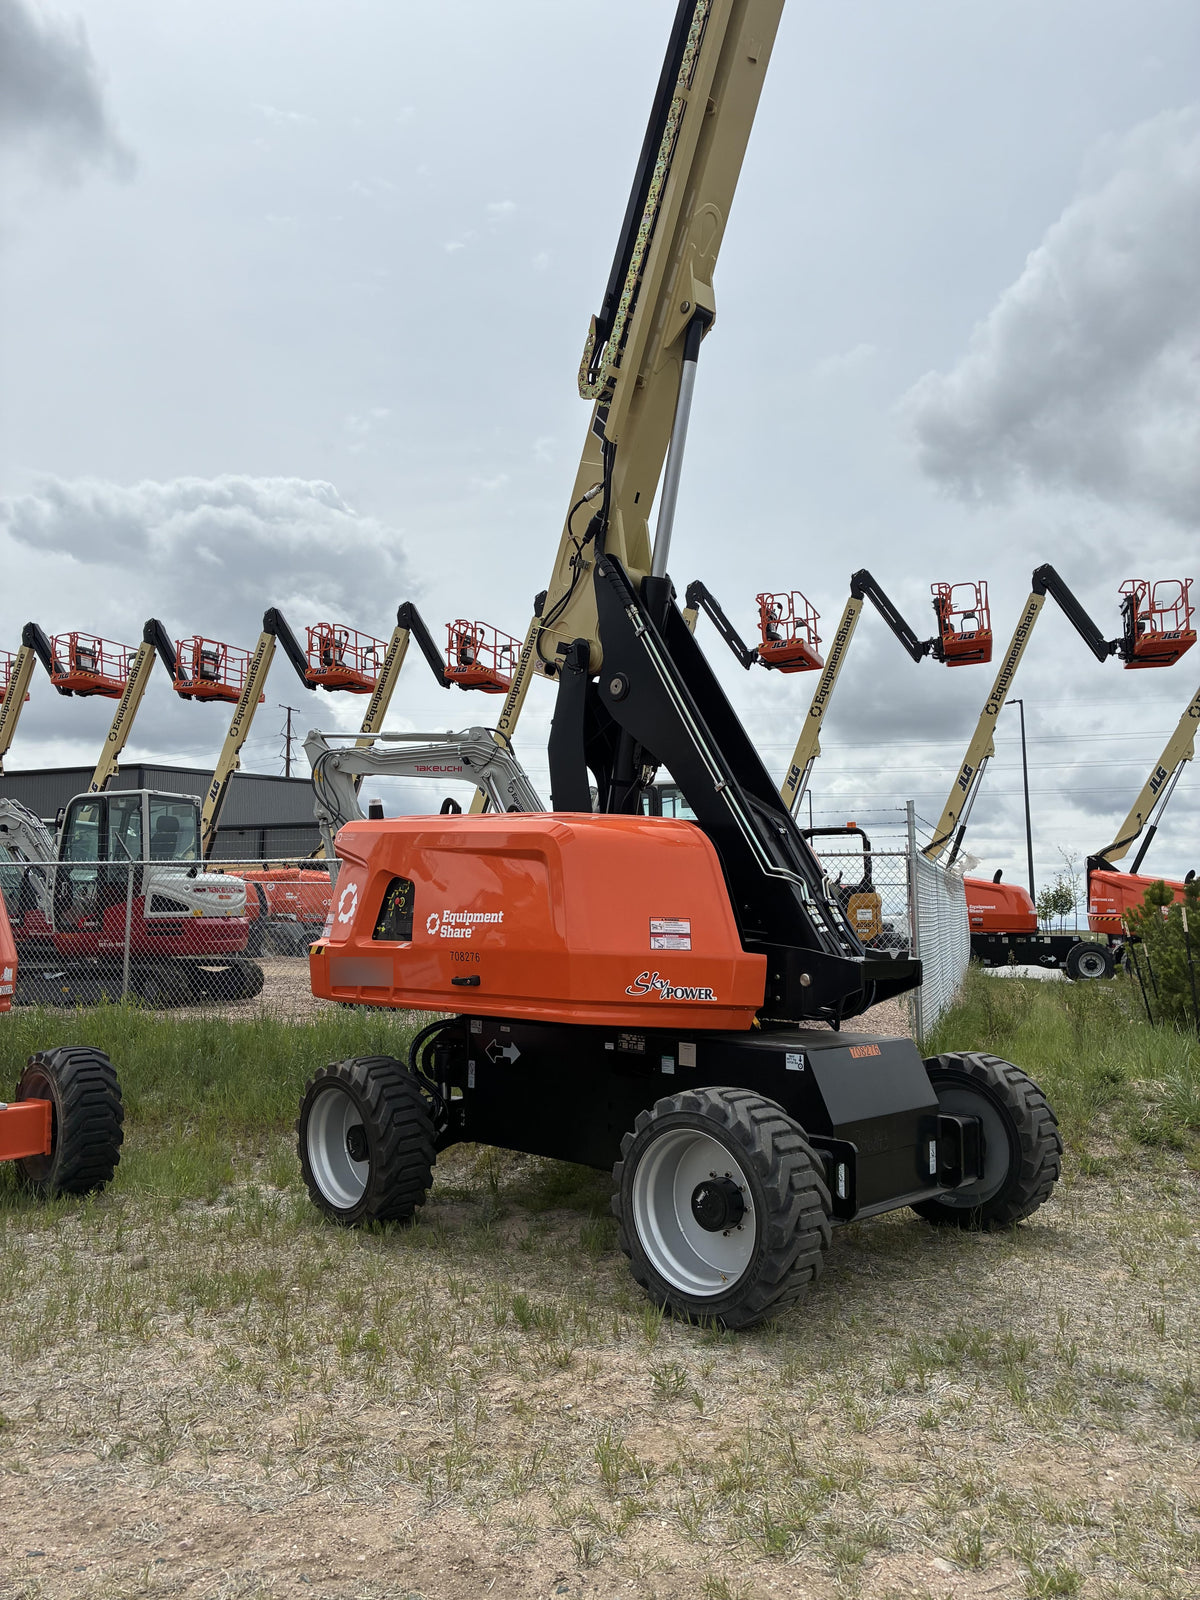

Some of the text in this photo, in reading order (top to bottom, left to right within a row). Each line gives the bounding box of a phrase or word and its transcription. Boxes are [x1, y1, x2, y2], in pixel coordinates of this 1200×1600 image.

[771, 640, 788, 648] JLG
[957, 631, 976, 640] JLG
[1160, 631, 1181, 640] JLG
[814, 608, 856, 705] EquipmentShare
[991, 602, 1038, 702] EquipmentShare
[234, 641, 267, 726] EquipmentShare
[366, 636, 401, 722] EquipmentShare
[503, 628, 539, 718] EquipmentShare
[113, 650, 146, 731] EquipmentShare
[414, 765, 463, 773] TAKEUCHI
[786, 765, 801, 792] JLG
[957, 764, 974, 792] JLG
[1149, 766, 1168, 795] JLG
[209, 780, 221, 803] JLG
[442, 910, 504, 925] Equipment
[440, 925, 472, 938] Share
[450, 951, 480, 962] 708276
[625, 971, 714, 1001] Sky POWER
[849, 1044, 880, 1058] 708276
